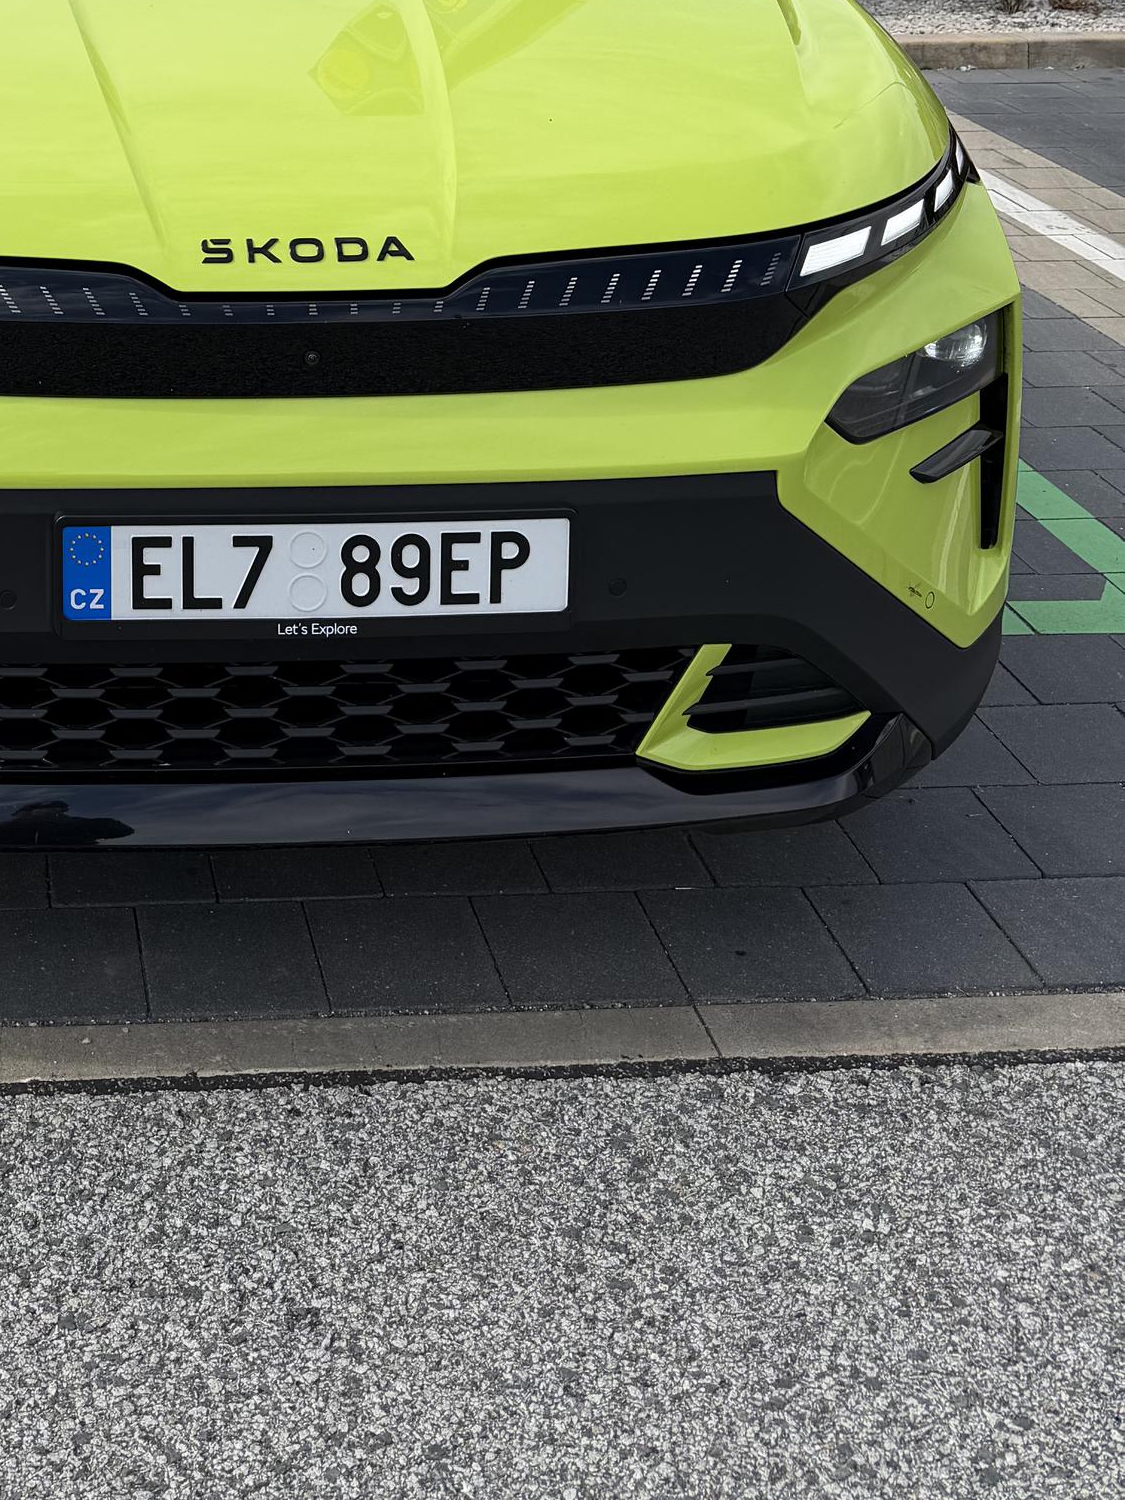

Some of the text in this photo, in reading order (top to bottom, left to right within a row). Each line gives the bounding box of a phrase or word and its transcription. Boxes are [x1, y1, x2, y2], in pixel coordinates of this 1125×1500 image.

[131, 530, 532, 610] EL7 89EP
[70, 587, 105, 610] CZ
[276, 622, 358, 638] Let's Explore
